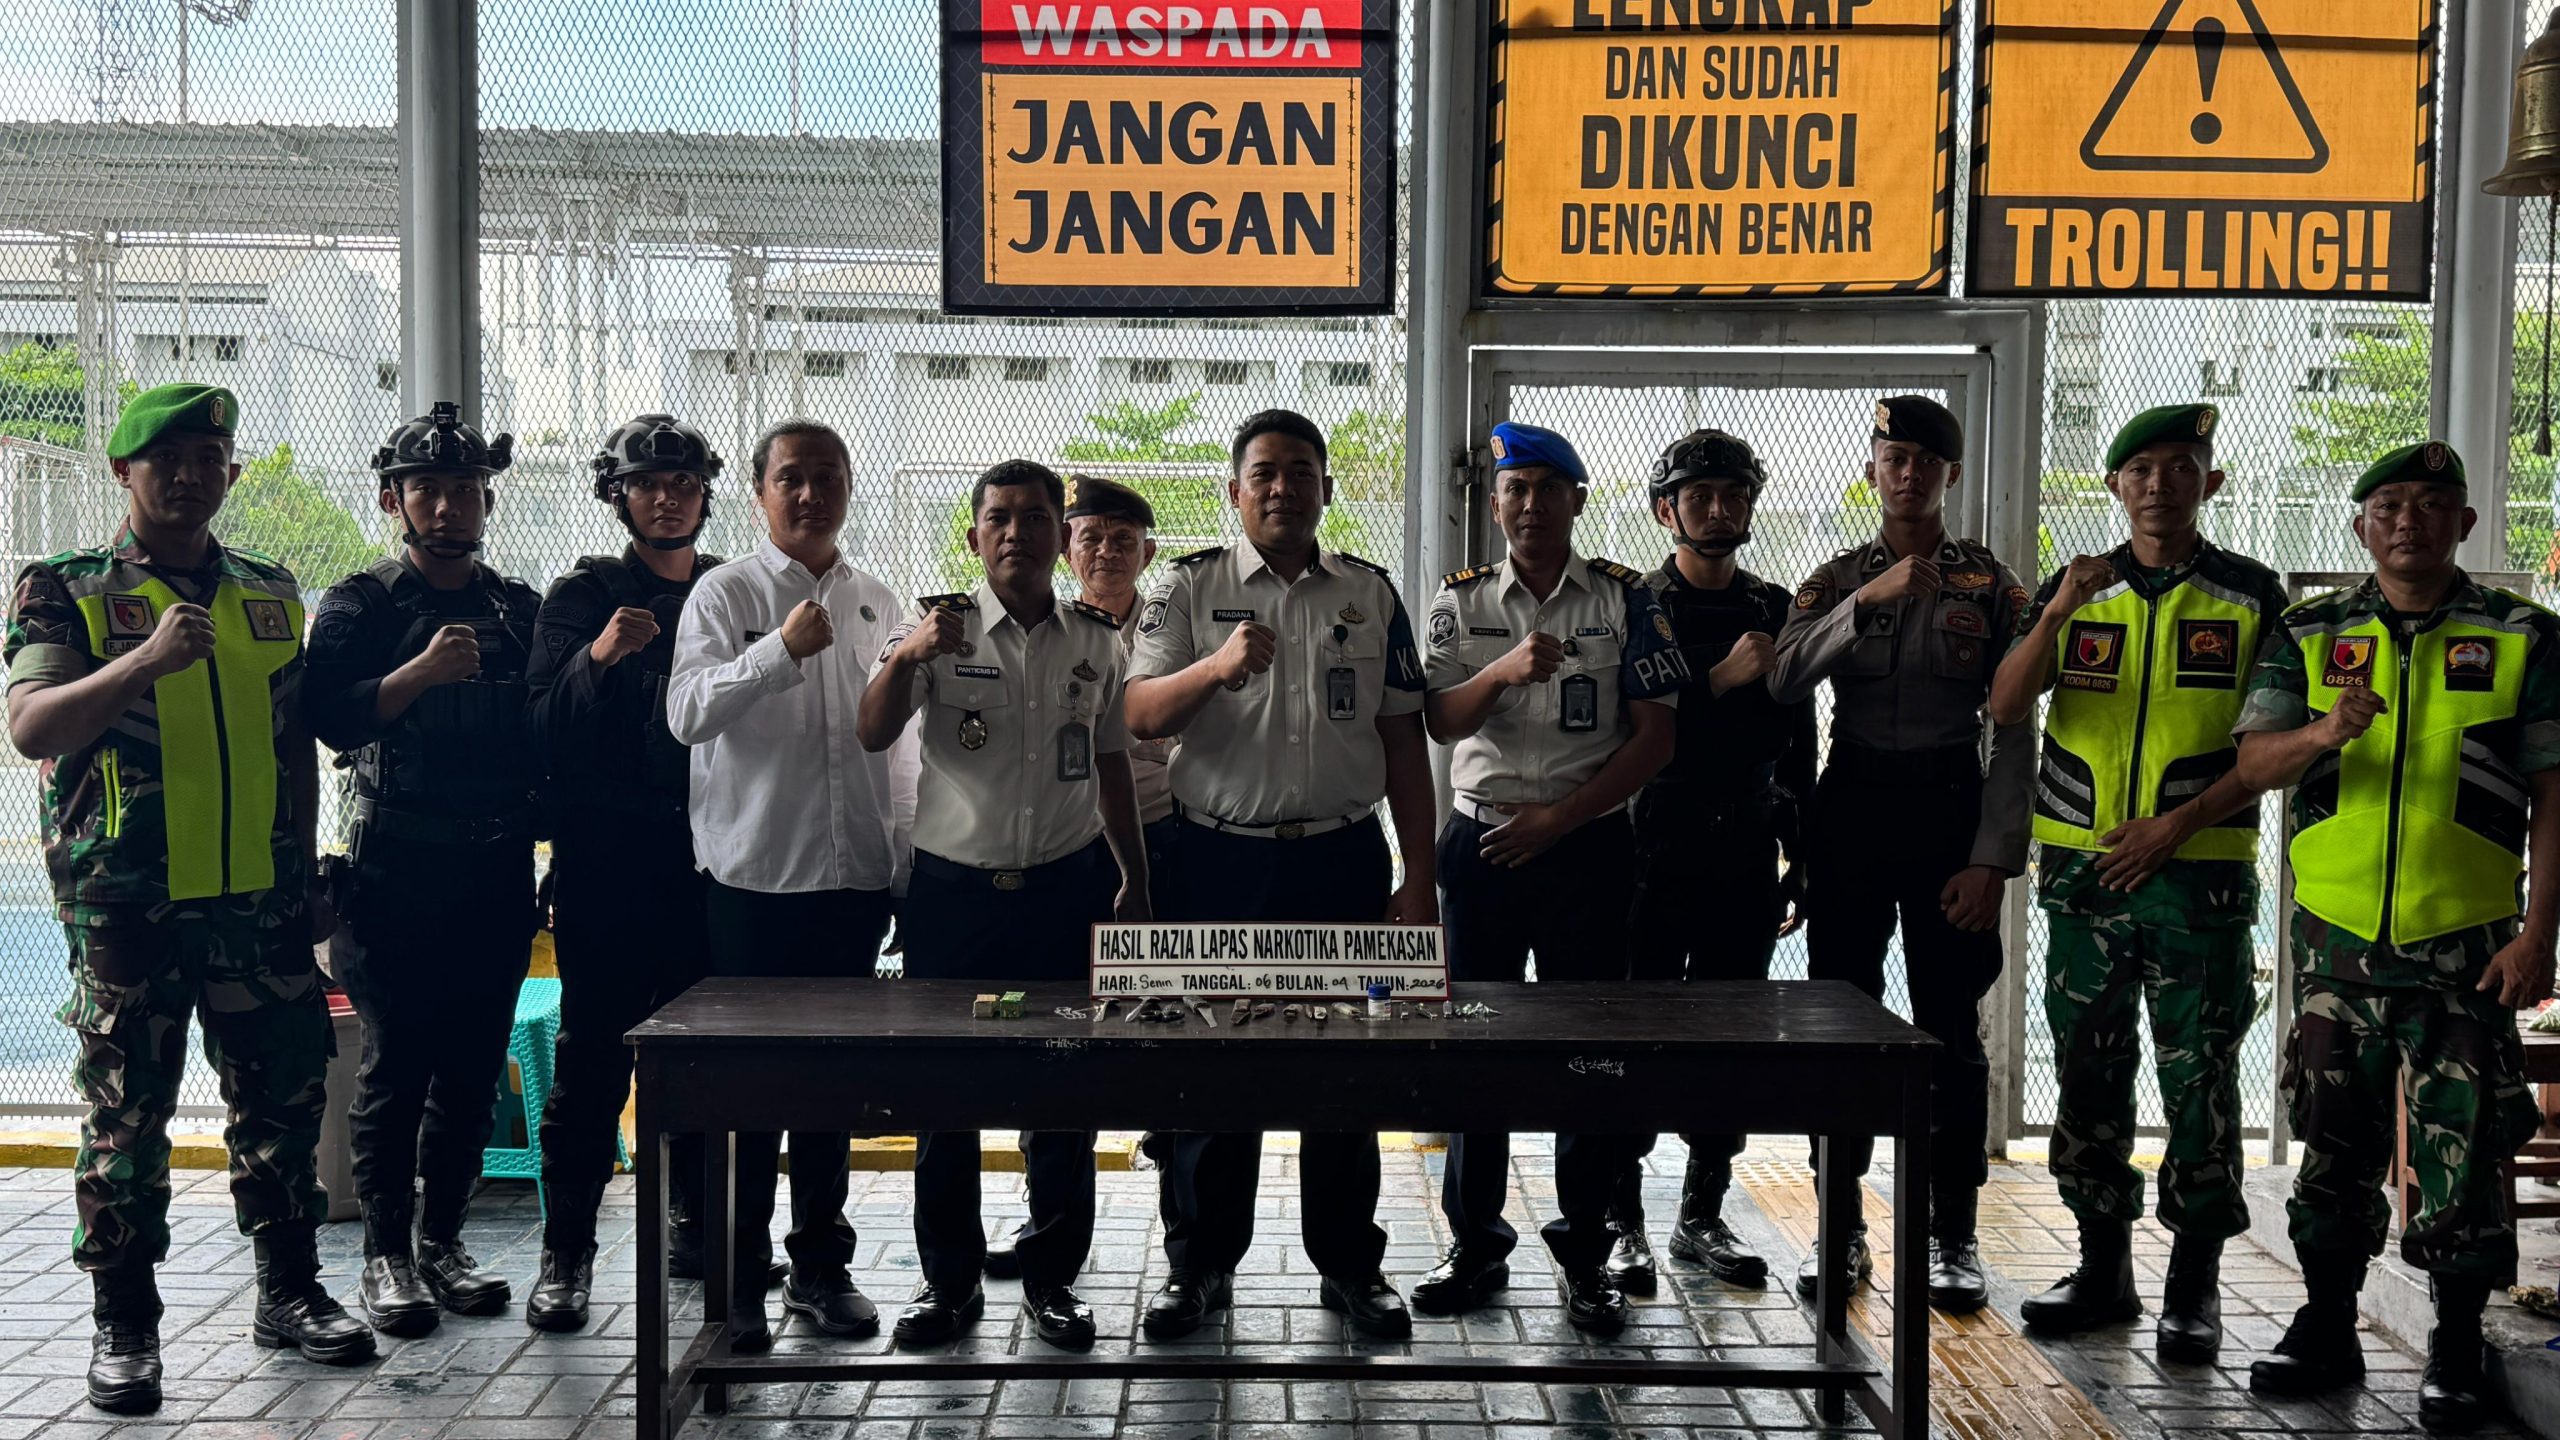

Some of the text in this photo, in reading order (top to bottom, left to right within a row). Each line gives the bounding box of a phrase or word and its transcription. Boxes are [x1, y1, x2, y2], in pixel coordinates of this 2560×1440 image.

[1011, 5, 1332, 58] WASPADA
[1606, 45, 1839, 99] DAN SUDAH
[1007, 100, 1336, 165] JANGAN
[1580, 112, 1857, 190] DIKUNCI
[1008, 190, 1335, 255] JANGAN
[1561, 201, 1872, 256] DENGAN BENAR
[2005, 209, 2390, 291] TROLLING!!
[1217, 611, 1252, 619] PRADANA
[2063, 675, 2091, 688] KODIM
[2326, 674, 2364, 686] 0826
[1100, 929, 1437, 961] HASIL RAZIA LAPAS NARKOTIKA PAMEKASAN
[1099, 975, 1137, 991] HARI:
[1181, 975, 1251, 991] TANGGAL:
[1276, 975, 1328, 991] BULAN:
